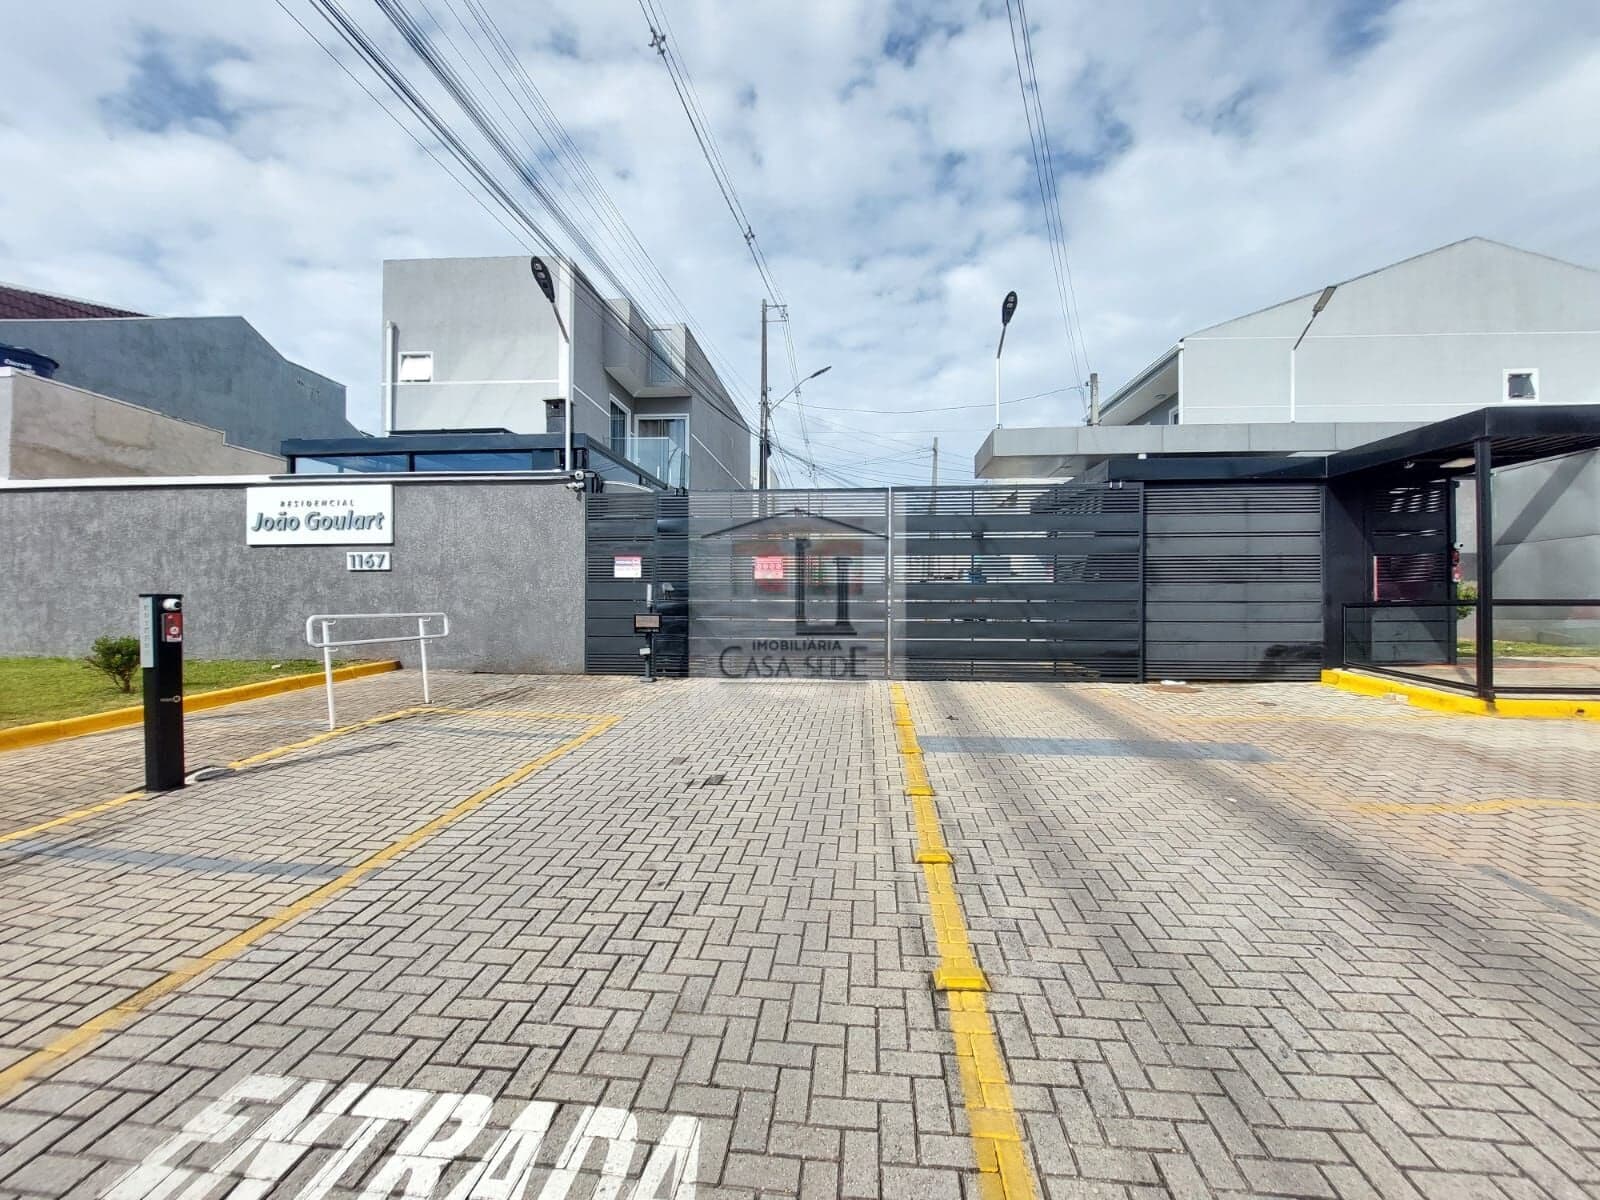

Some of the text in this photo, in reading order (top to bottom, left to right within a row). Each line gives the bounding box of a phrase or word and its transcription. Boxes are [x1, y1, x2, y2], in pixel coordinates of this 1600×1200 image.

[280, 499, 354, 508] RESIDENCIAL
[251, 510, 385, 532] João Goulart
[348, 553, 386, 569] 1167
[96, 1073, 702, 1200] ENTRADA
